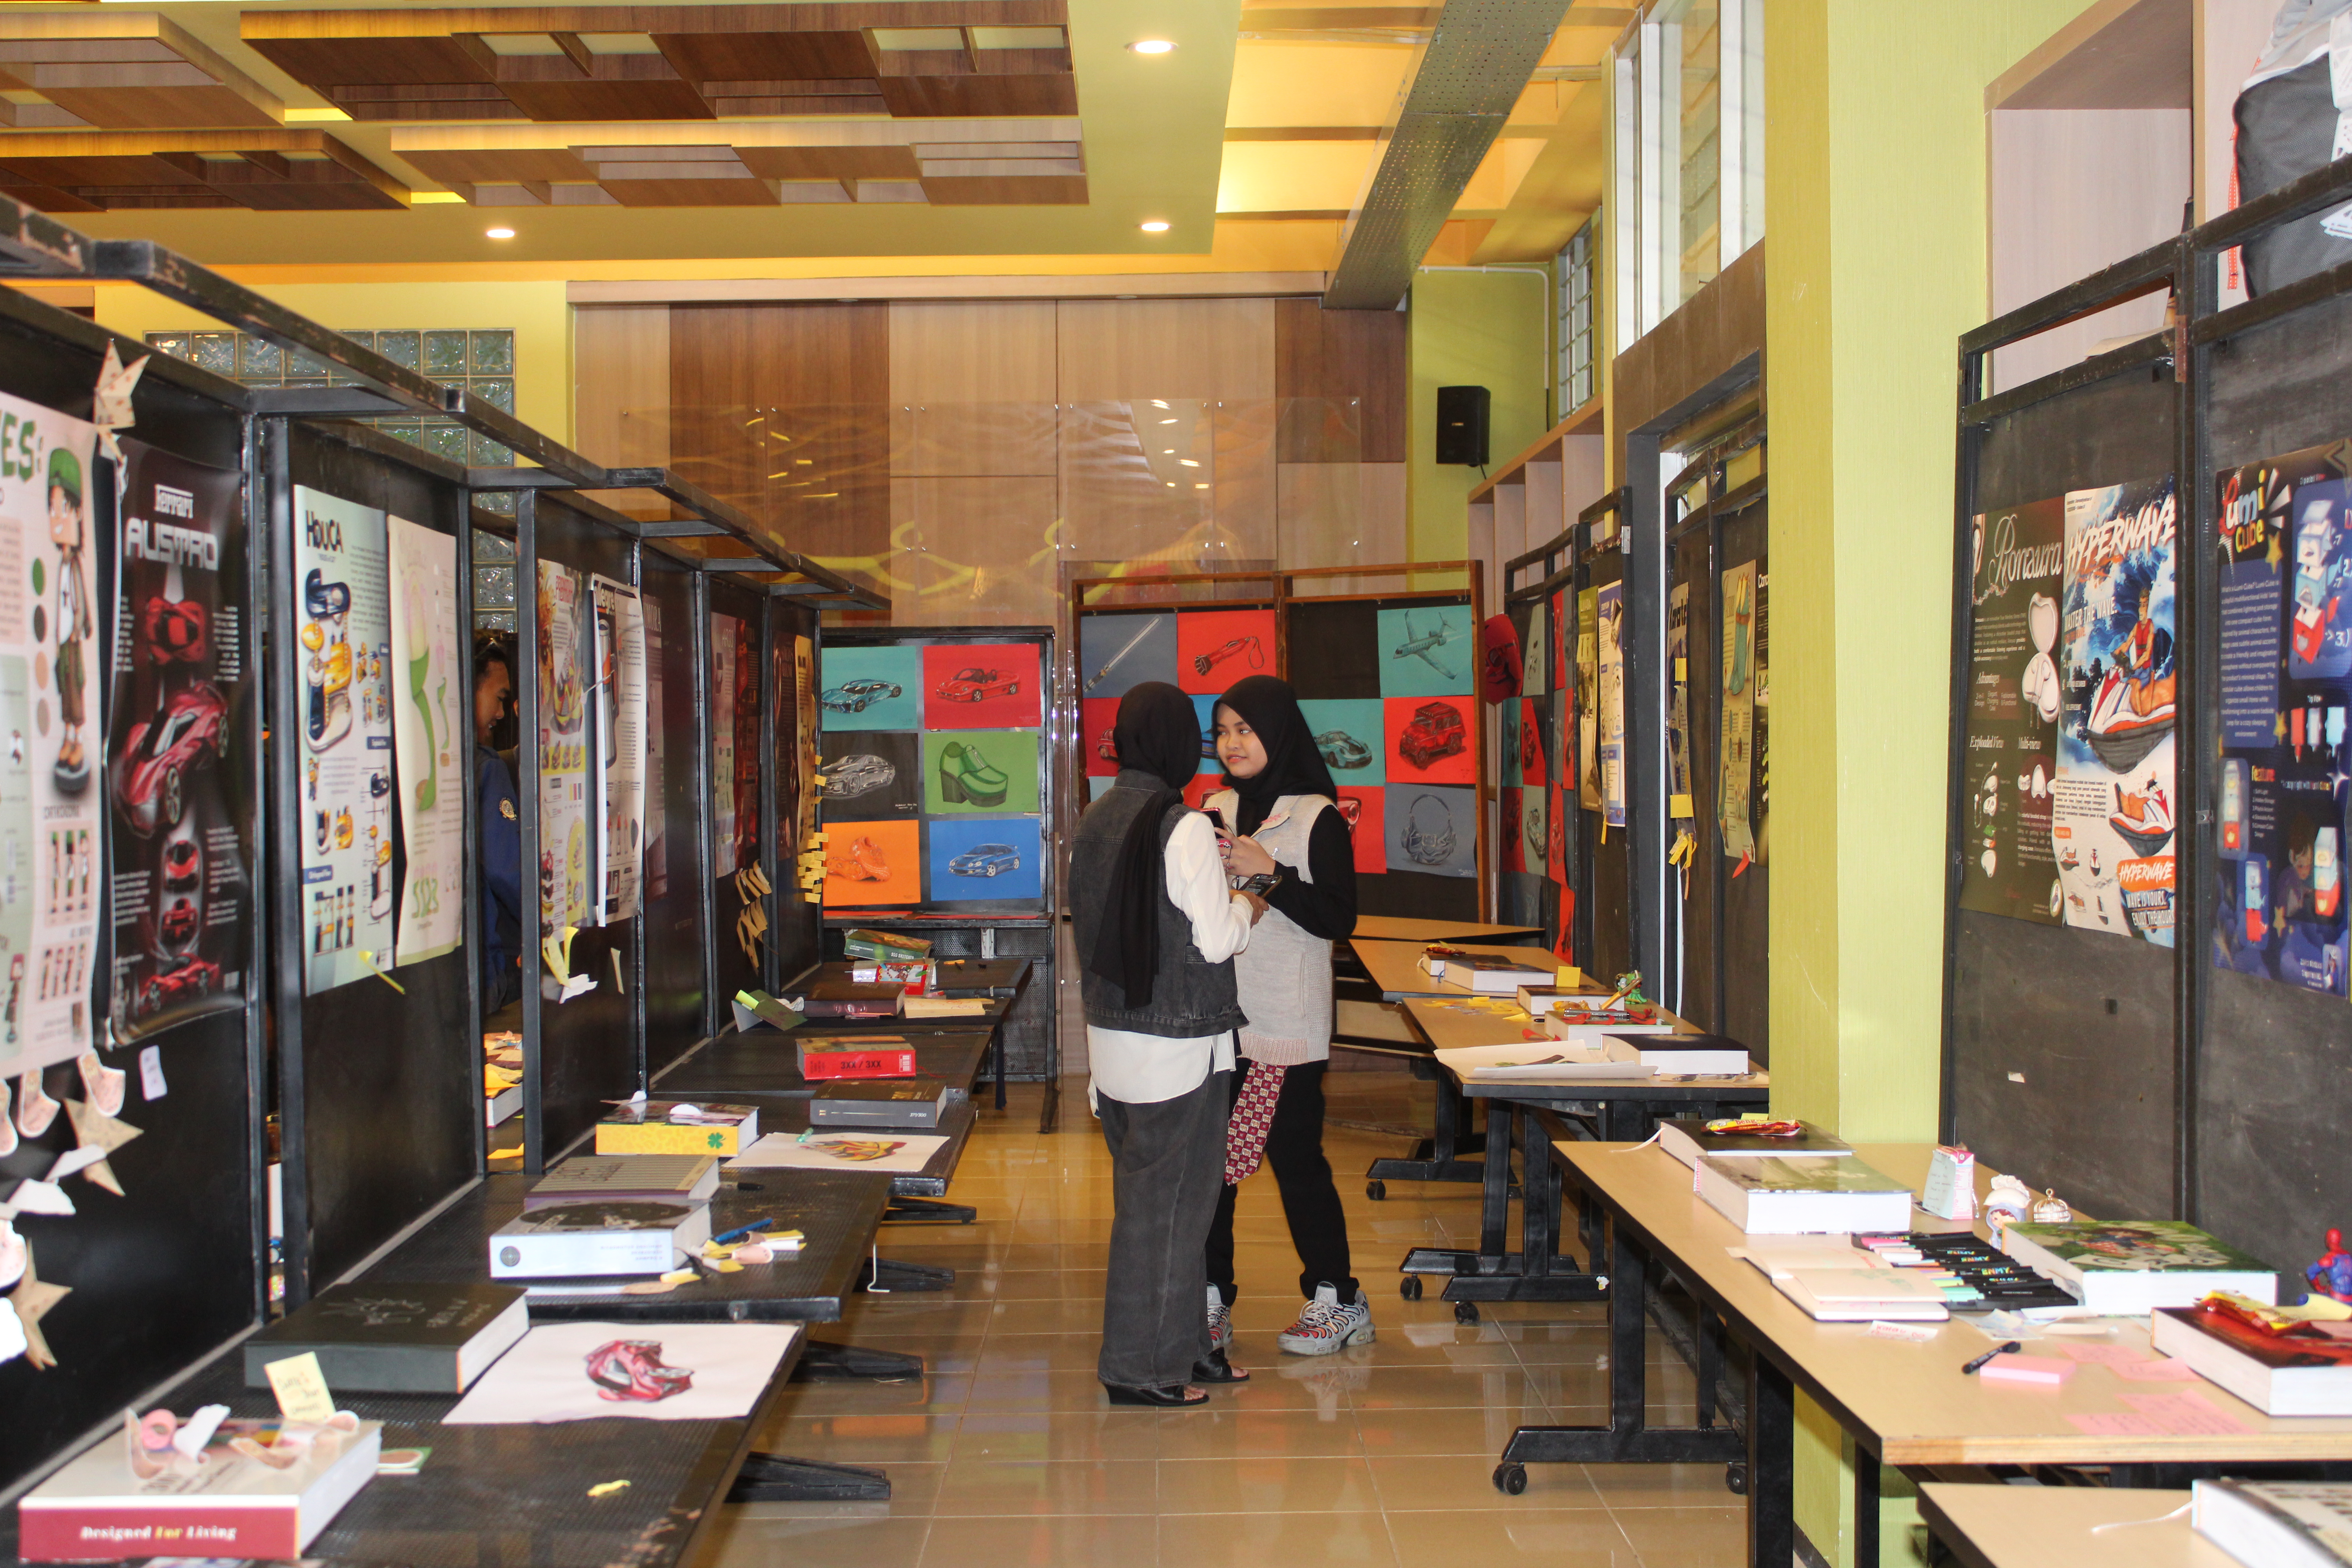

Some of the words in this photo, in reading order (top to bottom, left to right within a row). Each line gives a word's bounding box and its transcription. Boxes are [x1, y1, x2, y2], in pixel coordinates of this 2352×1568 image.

[0, 410, 44, 483] ES:
[2065, 493, 2176, 580] HYPERWAVE
[2083, 603, 2096, 624] THE
[2119, 861, 2174, 883] HYPERWAVE
[2126, 893, 2142, 908] WAVE
[2142, 893, 2147, 907] IS
[2132, 911, 2147, 926] ENJOY
[866, 1060, 882, 1068] 3XX
[80, 1524, 152, 1543] Designed
[186, 1524, 238, 1542] Living
